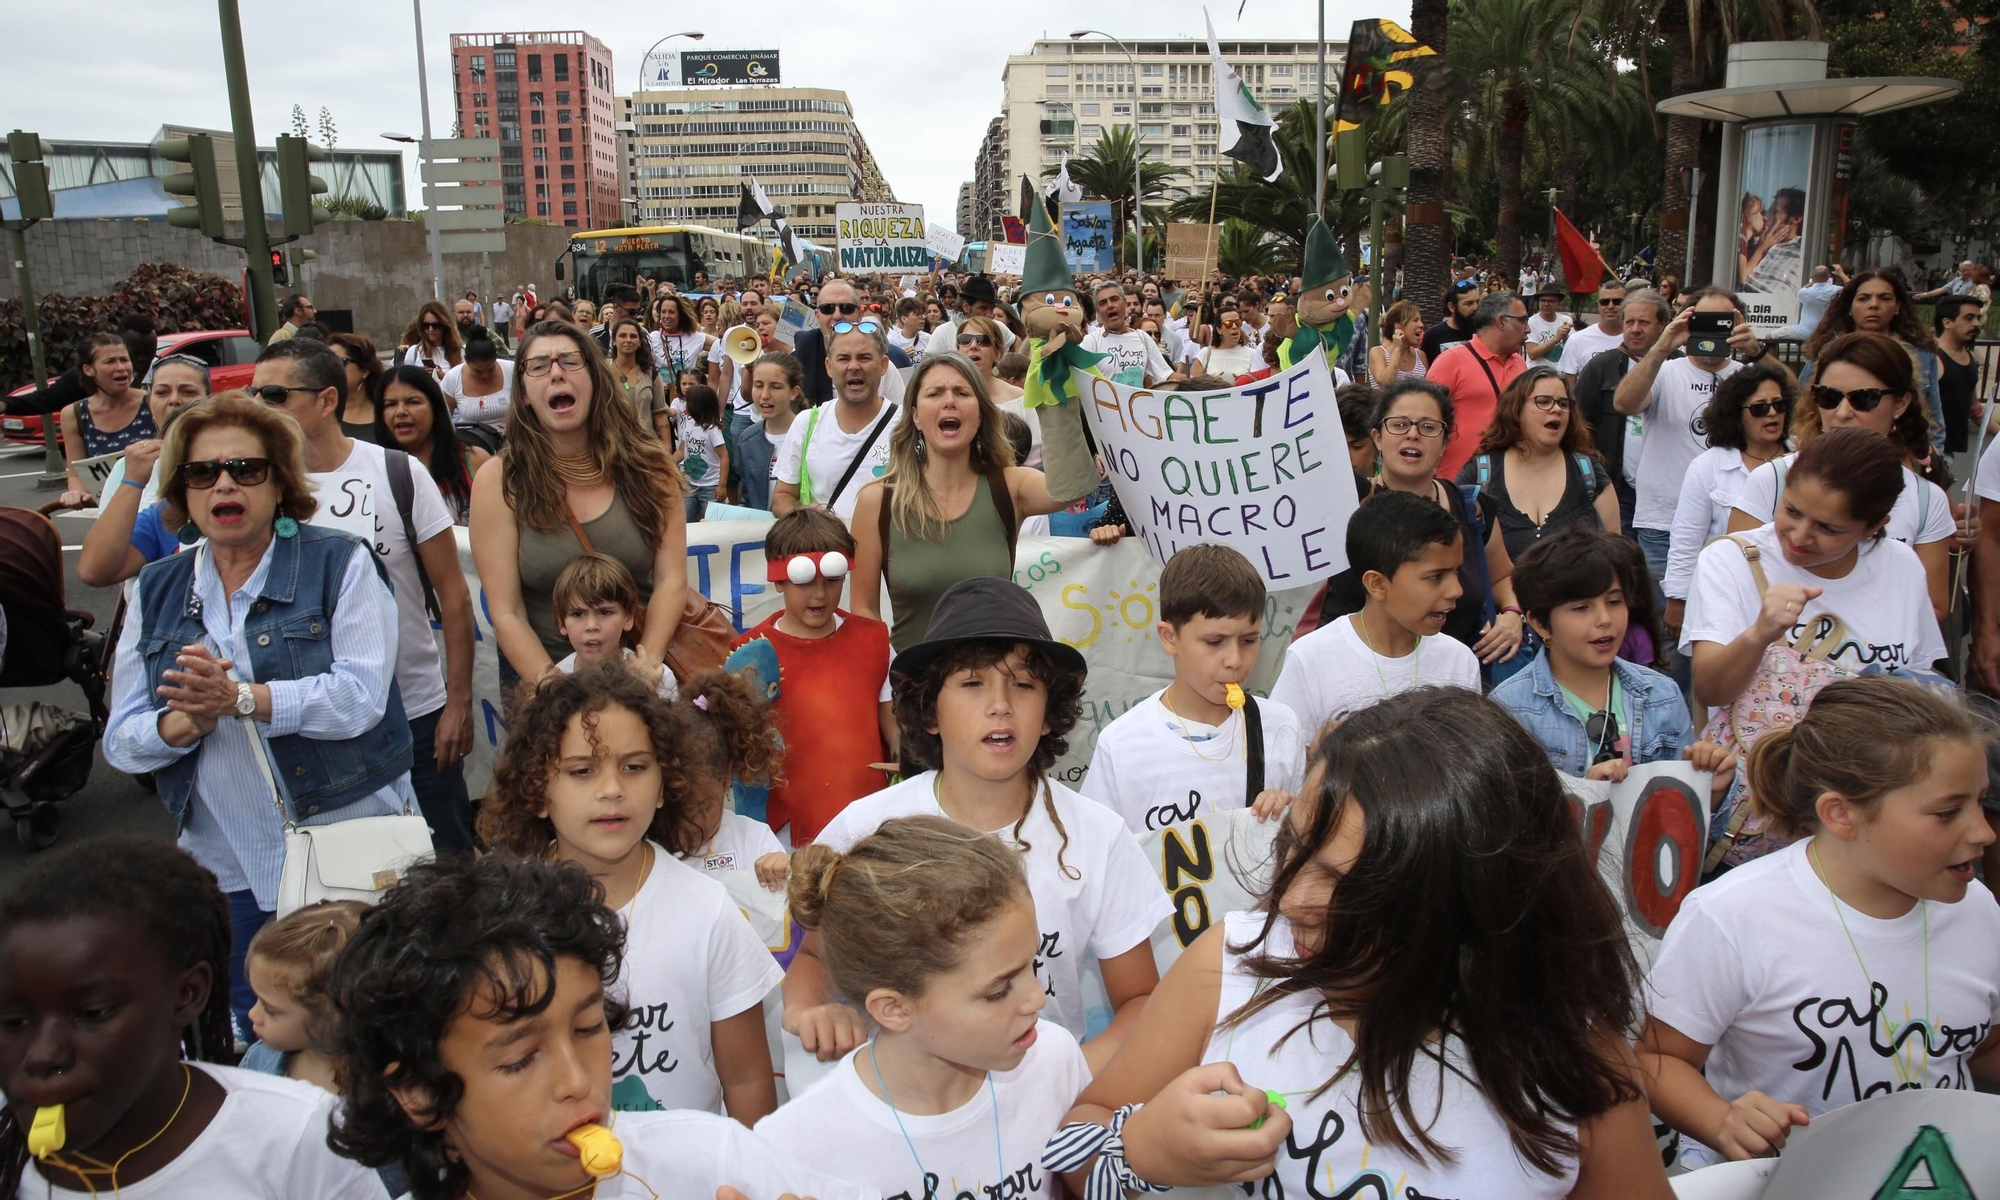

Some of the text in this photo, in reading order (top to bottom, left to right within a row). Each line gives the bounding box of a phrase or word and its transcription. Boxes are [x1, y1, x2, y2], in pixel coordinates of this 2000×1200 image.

[750, 52, 778, 60] JINÁMAR
[698, 77, 730, 85] Mirador
[860, 204, 905, 216] NUESTRA
[1070, 211, 1111, 229] Salvar
[840, 217, 925, 239] RIQUEZA
[571, 243, 587, 252] 634
[594, 240, 607, 253] 12
[622, 237, 650, 245] PUERTO
[636, 242, 660, 250] PLATA
[1067, 233, 1107, 255] Agaete
[840, 246, 929, 268] NATURALEZA
[1167, 243, 1180, 256] NO
[1753, 303, 1772, 313] DÍA
[1108, 345, 1144, 364] Salvar
[1091, 368, 1315, 445] AGAETE
[1100, 438, 1140, 482] NO
[1160, 428, 1323, 497] QUIERE
[1150, 493, 1297, 537] MACRO
[1129, 514, 1332, 580] MULE
[706, 856, 733, 868] STOP
